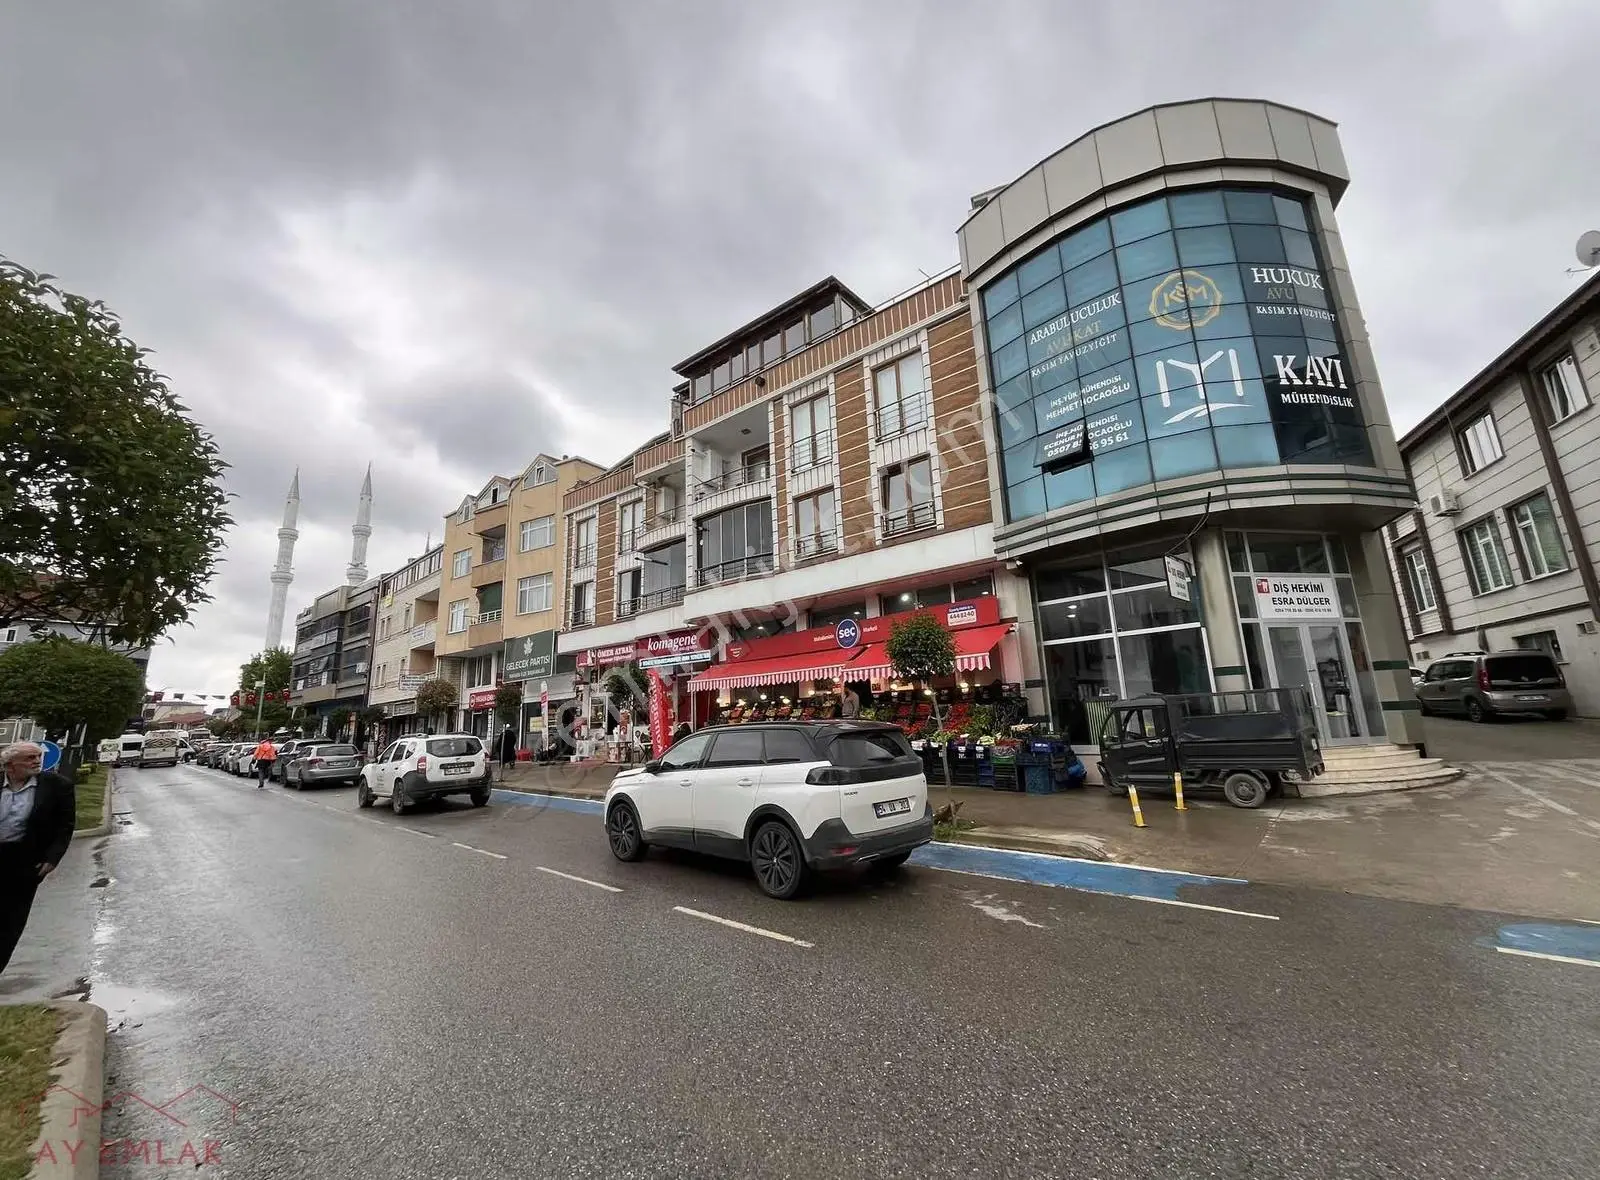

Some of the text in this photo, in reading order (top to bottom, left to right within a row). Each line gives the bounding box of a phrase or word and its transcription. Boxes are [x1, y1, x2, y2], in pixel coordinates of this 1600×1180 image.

[1250, 267, 1324, 290] HUKUK
[1030, 293, 1121, 345] ARABULUCULUK
[1273, 355, 1348, 389] KAYI
[1046, 402, 1079, 421] MEHMET
[1047, 443, 1070, 457] 0507
[1100, 436, 1114, 447] 95
[1115, 431, 1129, 442] 61
[1273, 581, 1289, 594] DİŞ
[1272, 595, 1331, 606] ESRA DÜLGER
[648, 634, 697, 651] komagene
